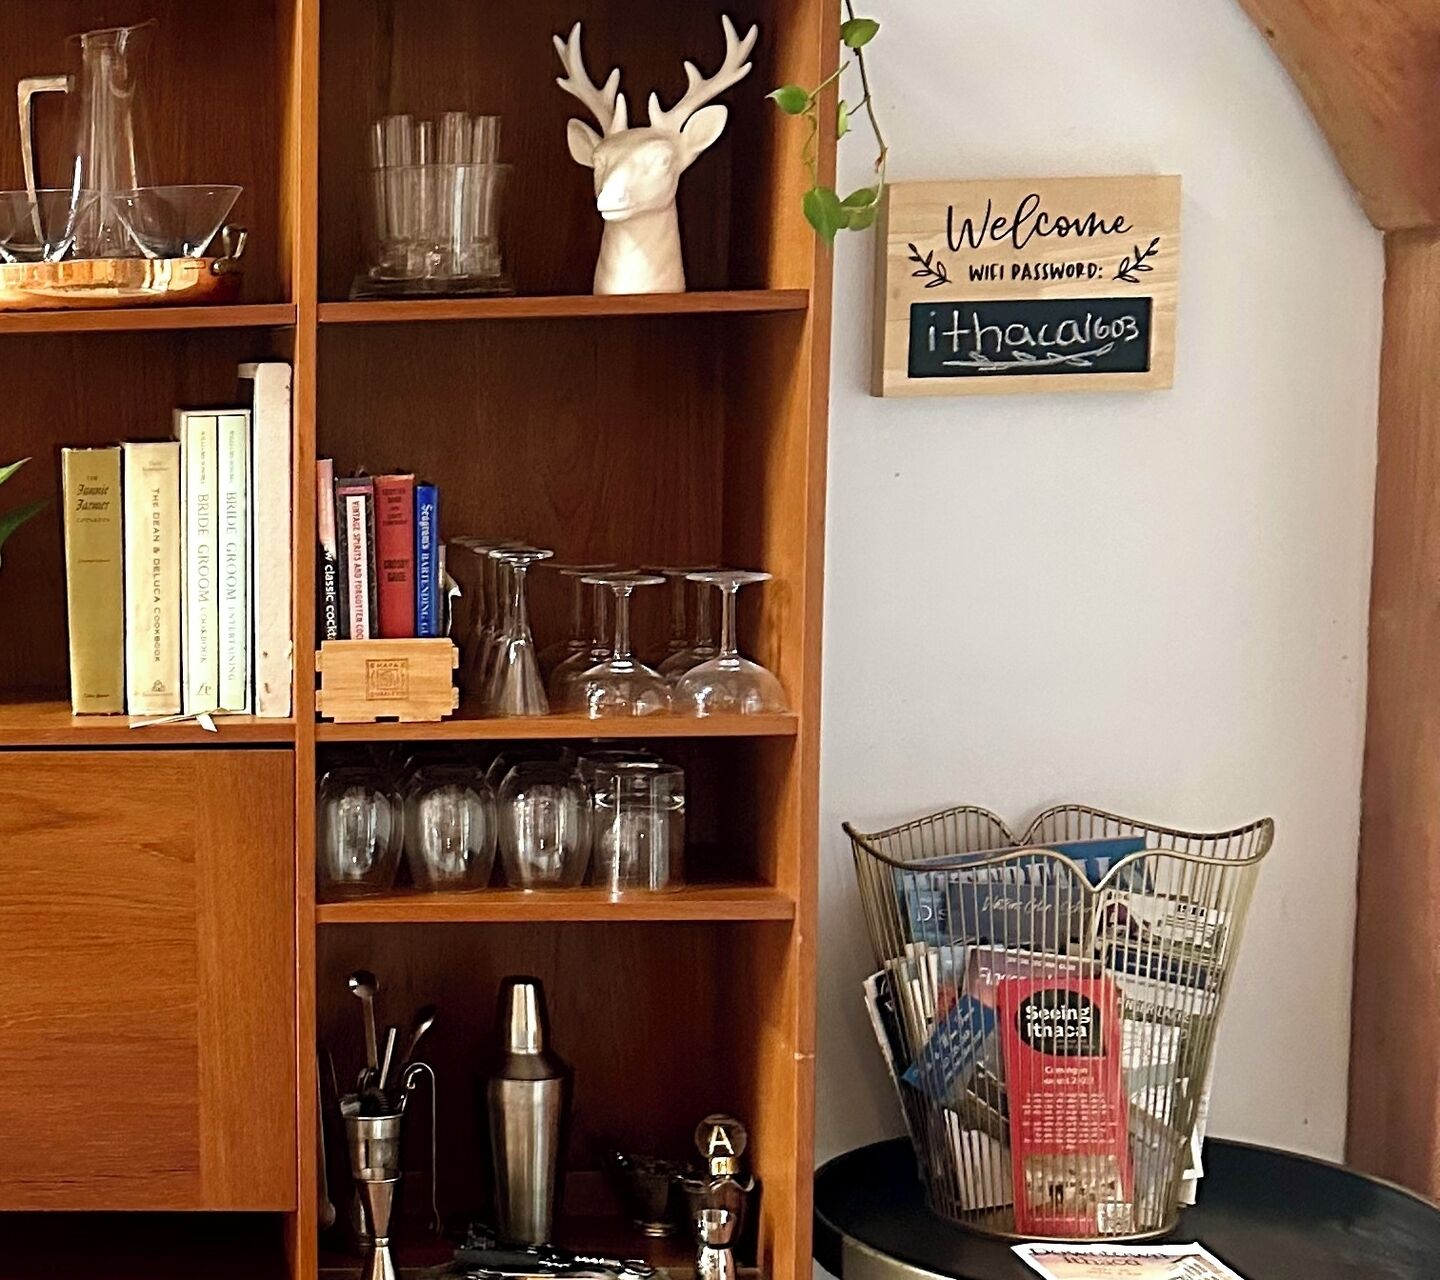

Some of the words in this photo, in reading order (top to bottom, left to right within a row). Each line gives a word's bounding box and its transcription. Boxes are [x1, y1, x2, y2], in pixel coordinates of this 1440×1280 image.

[947, 193, 1133, 252] Welcome
[969, 264, 1004, 282] WIFI
[1011, 263, 1103, 281] PASSWORD:
[152, 488, 160, 508] THE
[197, 494, 209, 536] BRIDE
[226, 492, 237, 535] BRIDE
[352, 501, 360, 531] VINTAGE
[353, 533, 361, 561] SPIRITS
[153, 558, 161, 603] DELUCA
[197, 544, 209, 603] GROOM
[226, 542, 237, 600] GROOM
[324, 565, 336, 601] classic
[354, 564, 362, 578] AND
[421, 553, 430, 618] BARTENDING
[355, 581, 363, 622] FORGOTTEN
[1025, 1005, 1090, 1024] Seeing
[1027, 1023, 1088, 1038] Ithaca
[708, 1125, 735, 1155] A
